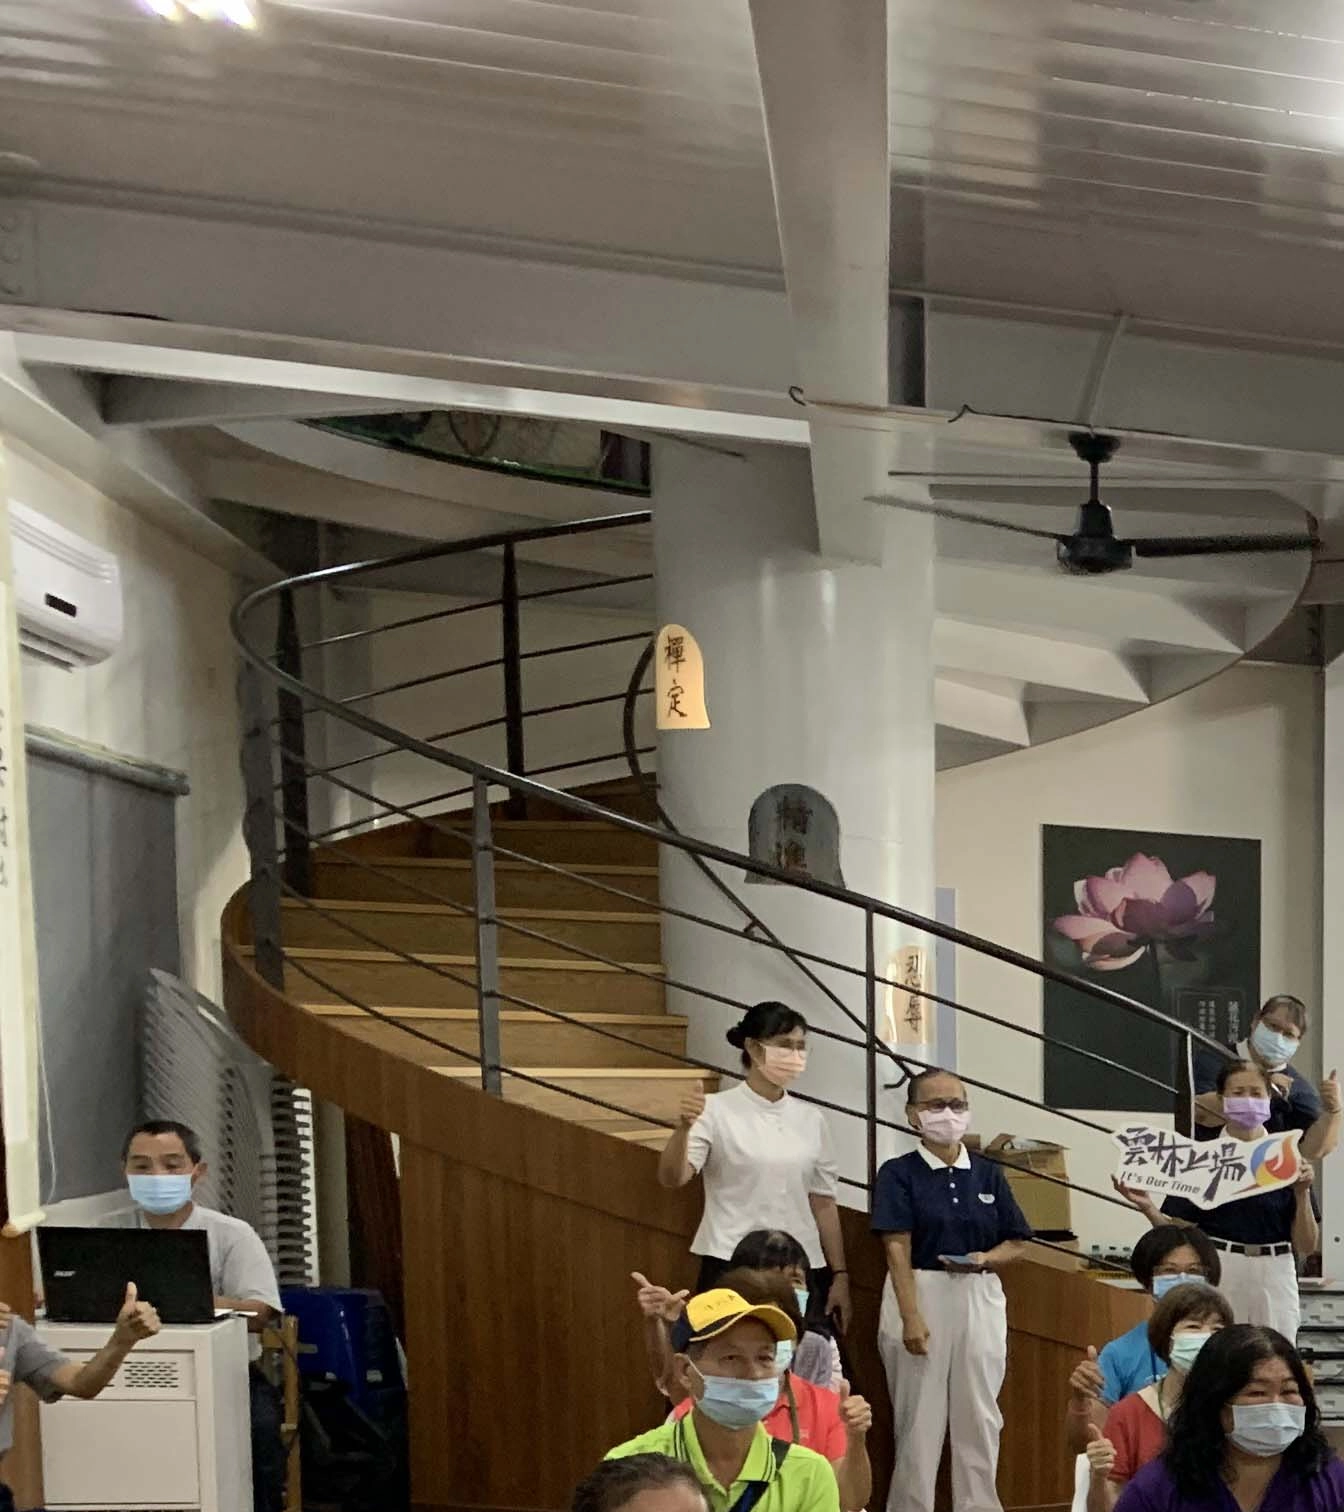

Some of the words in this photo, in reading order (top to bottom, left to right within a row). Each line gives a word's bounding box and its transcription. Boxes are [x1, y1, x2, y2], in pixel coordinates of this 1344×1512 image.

[664, 635, 687, 718] 禪定
[1116, 1127, 1247, 1202] 雲林上場
[1146, 1173, 1168, 1188] Our
